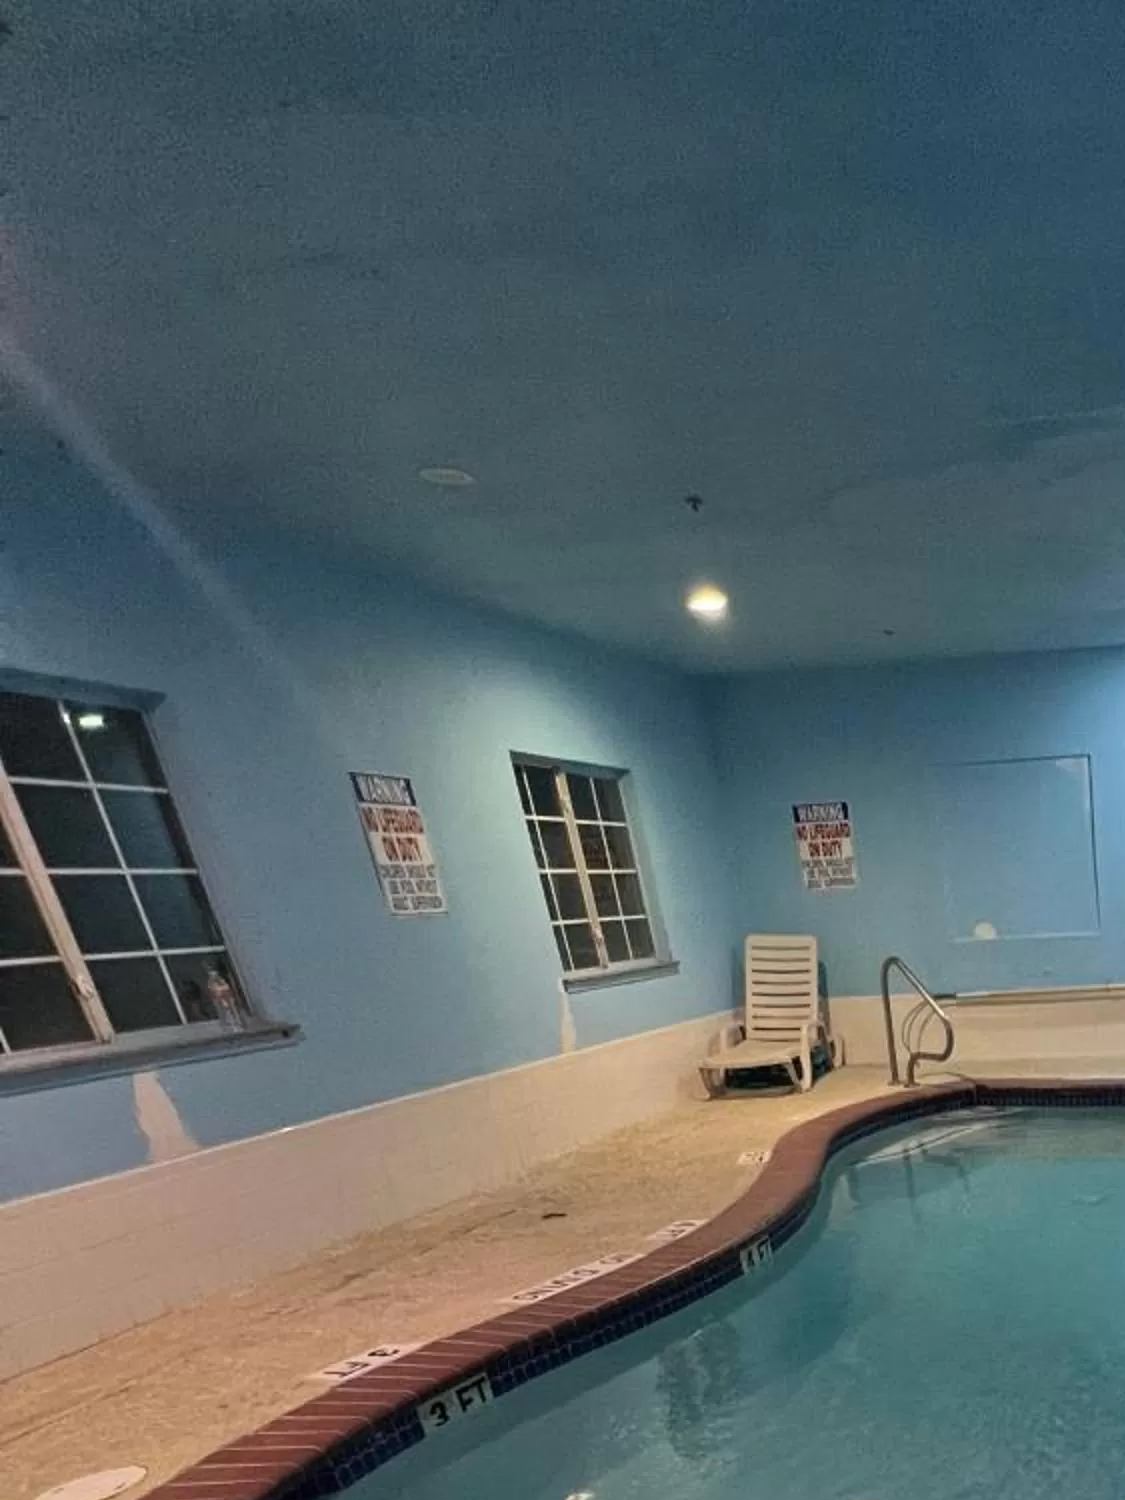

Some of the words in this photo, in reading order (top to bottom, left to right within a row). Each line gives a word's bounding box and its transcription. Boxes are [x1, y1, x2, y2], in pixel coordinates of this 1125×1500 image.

[355, 775, 412, 805] WARNING
[798, 804, 843, 822] WARNING
[796, 824, 808, 841] NO
[808, 822, 850, 840] LIFEGUARD
[809, 842, 821, 857] ON
[821, 841, 843, 857] DUTY
[429, 1401, 450, 1428] 3
[456, 1376, 488, 1413] FT
